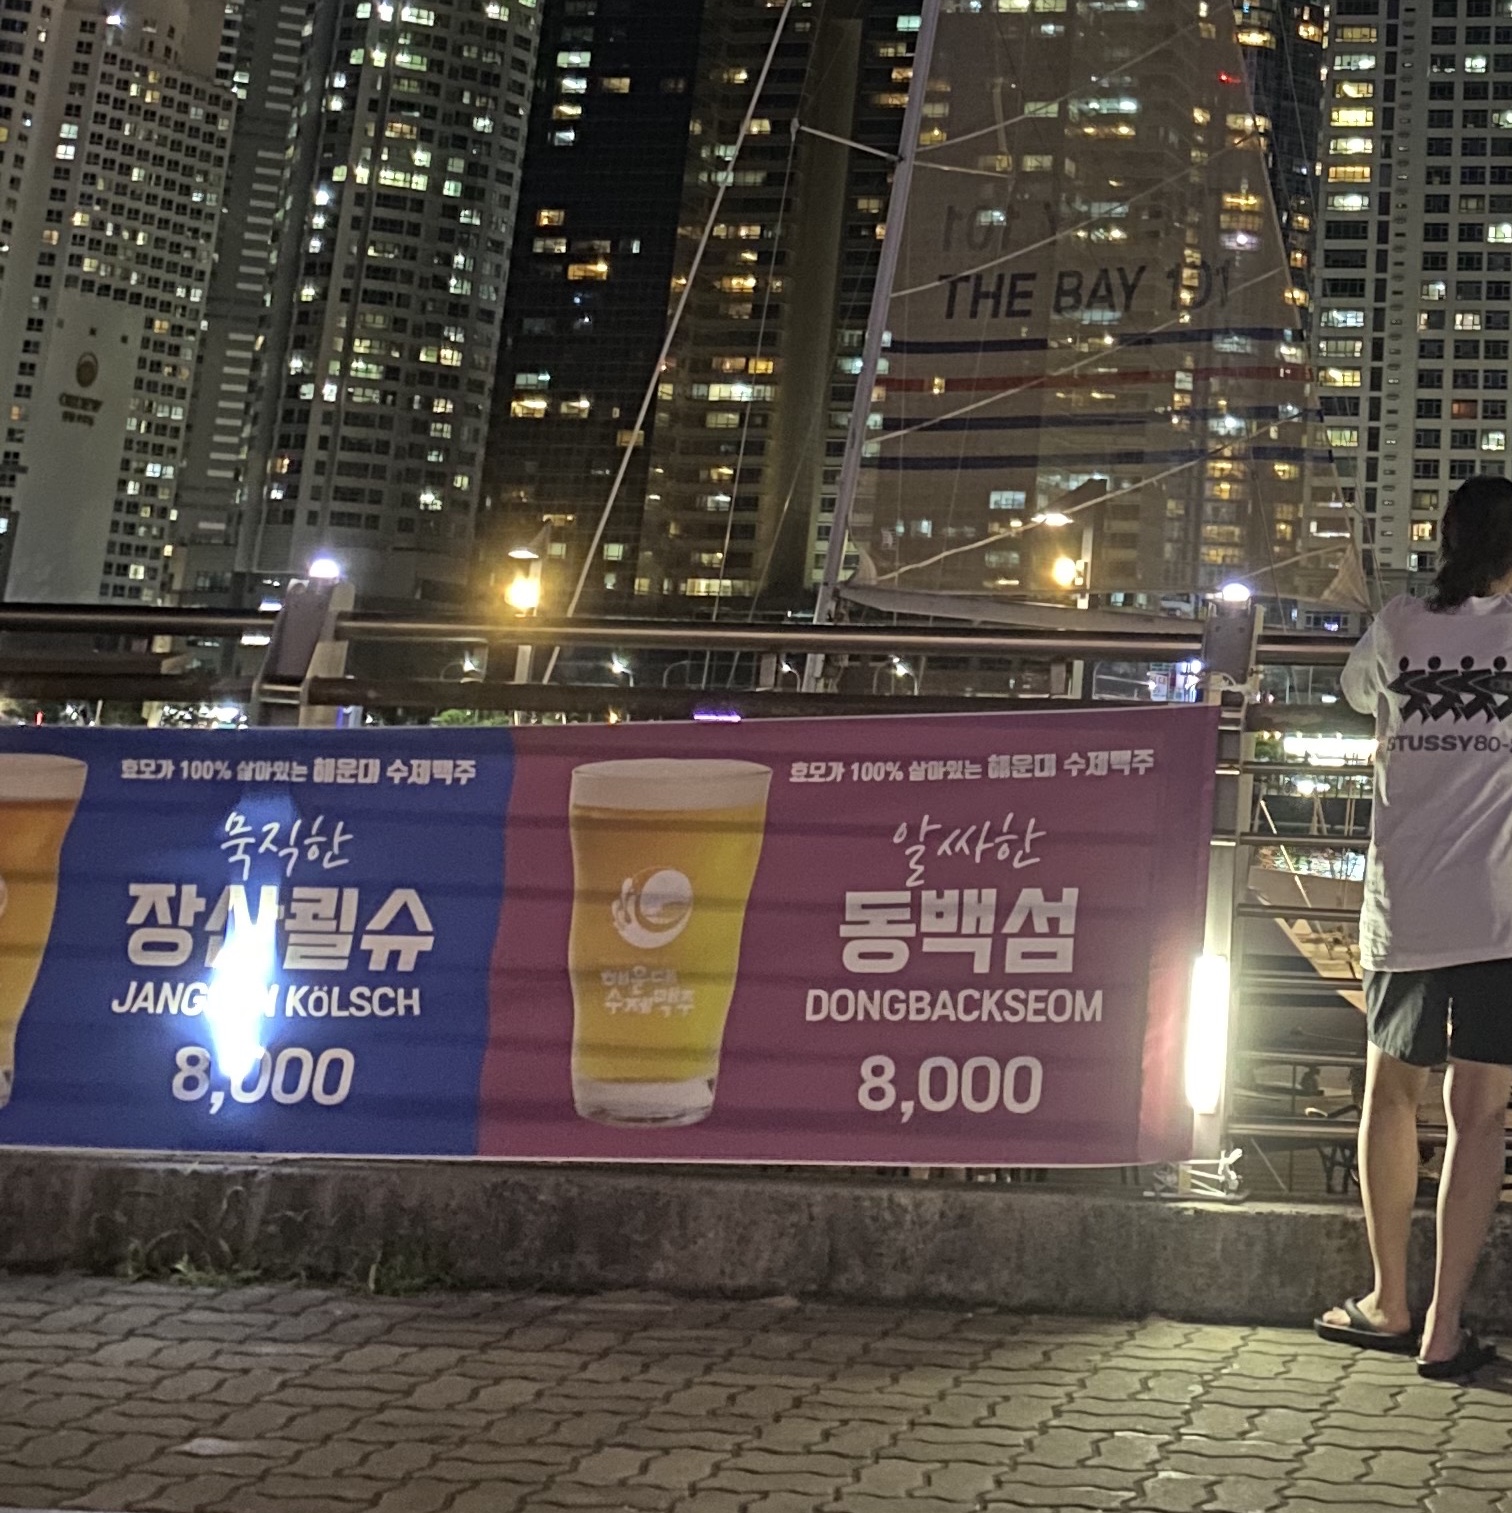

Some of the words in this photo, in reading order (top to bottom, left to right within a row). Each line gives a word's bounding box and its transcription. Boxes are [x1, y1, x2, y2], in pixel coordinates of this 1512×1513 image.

[938, 271, 1038, 320] THE
[1053, 265, 1147, 313] BAY
[121, 758, 175, 780] 효모가
[180, 759, 233, 780] 100%
[236, 759, 308, 782] 살아있는
[312, 757, 380, 783] 해운대
[386, 758, 476, 786] 수제맥주
[789, 761, 845, 783] 효모가
[850, 761, 904, 782] 100%
[908, 760, 982, 781] 살아있는
[987, 752, 1057, 779] 해운대
[1063, 748, 1155, 777] 수제맥주
[220, 811, 354, 879] 묵직한
[892, 811, 1047, 888] 알싸한
[839, 887, 1079, 975] 동백섬
[805, 988, 1104, 1022] DONGBACKSEOM
[171, 1045, 355, 1115] 8,000
[857, 1054, 1043, 1124] 8,000
